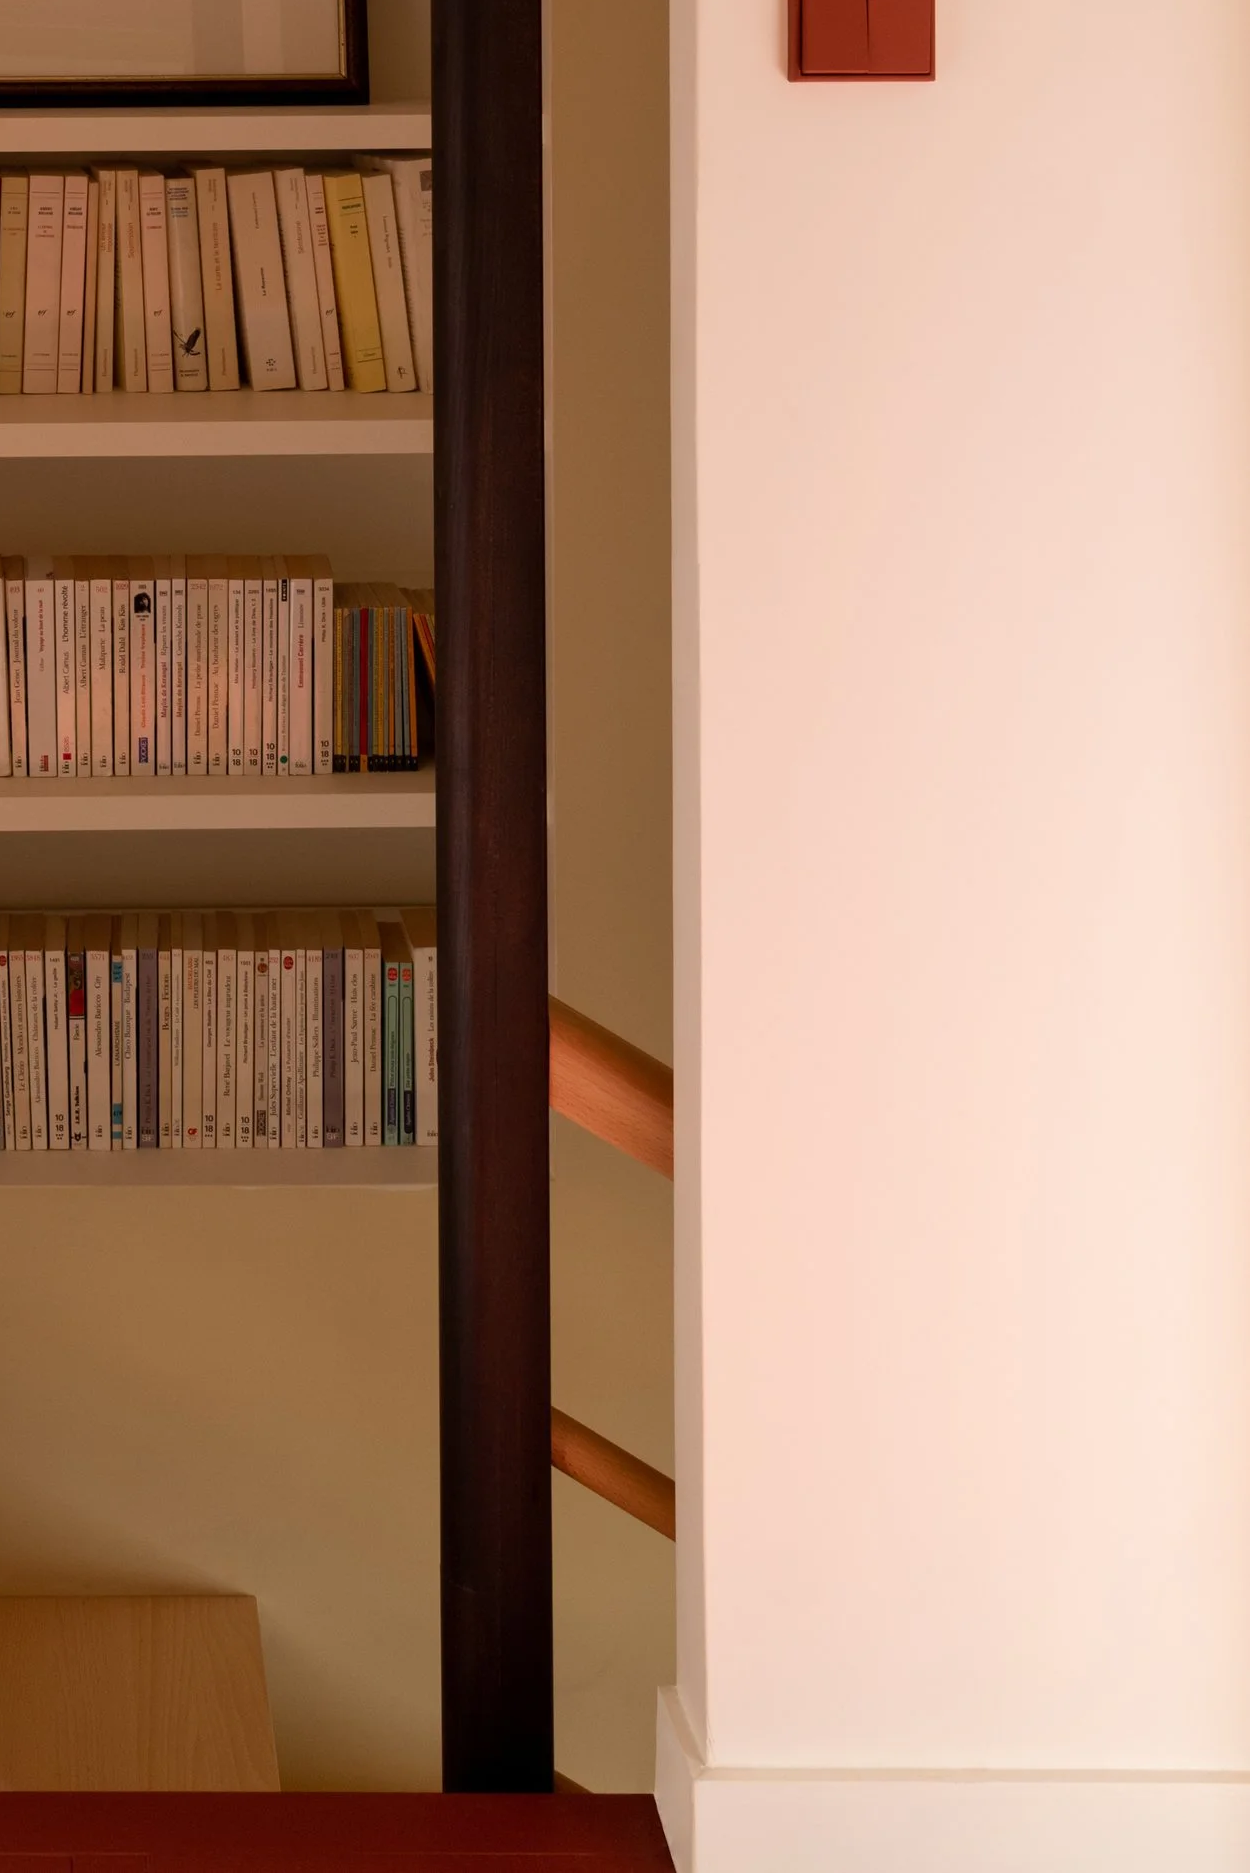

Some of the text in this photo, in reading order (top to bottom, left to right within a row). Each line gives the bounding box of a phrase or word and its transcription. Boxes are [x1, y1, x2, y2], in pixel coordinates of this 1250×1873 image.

[61, 610, 69, 643] L'homme
[321, 740, 330, 748] 10
[232, 748, 242, 756] 10
[249, 748, 259, 756] 10
[321, 750, 330, 758] 18
[232, 758, 242, 766] 18
[249, 758, 259, 766] 18
[270, 1100, 278, 1117] Jules
[55, 1114, 64, 1122] 10
[205, 1114, 214, 1122] 10
[241, 1116, 250, 1124] 10
[55, 1124, 64, 1132] 18
[205, 1125, 214, 1133] 18
[241, 1126, 250, 1134] 18
